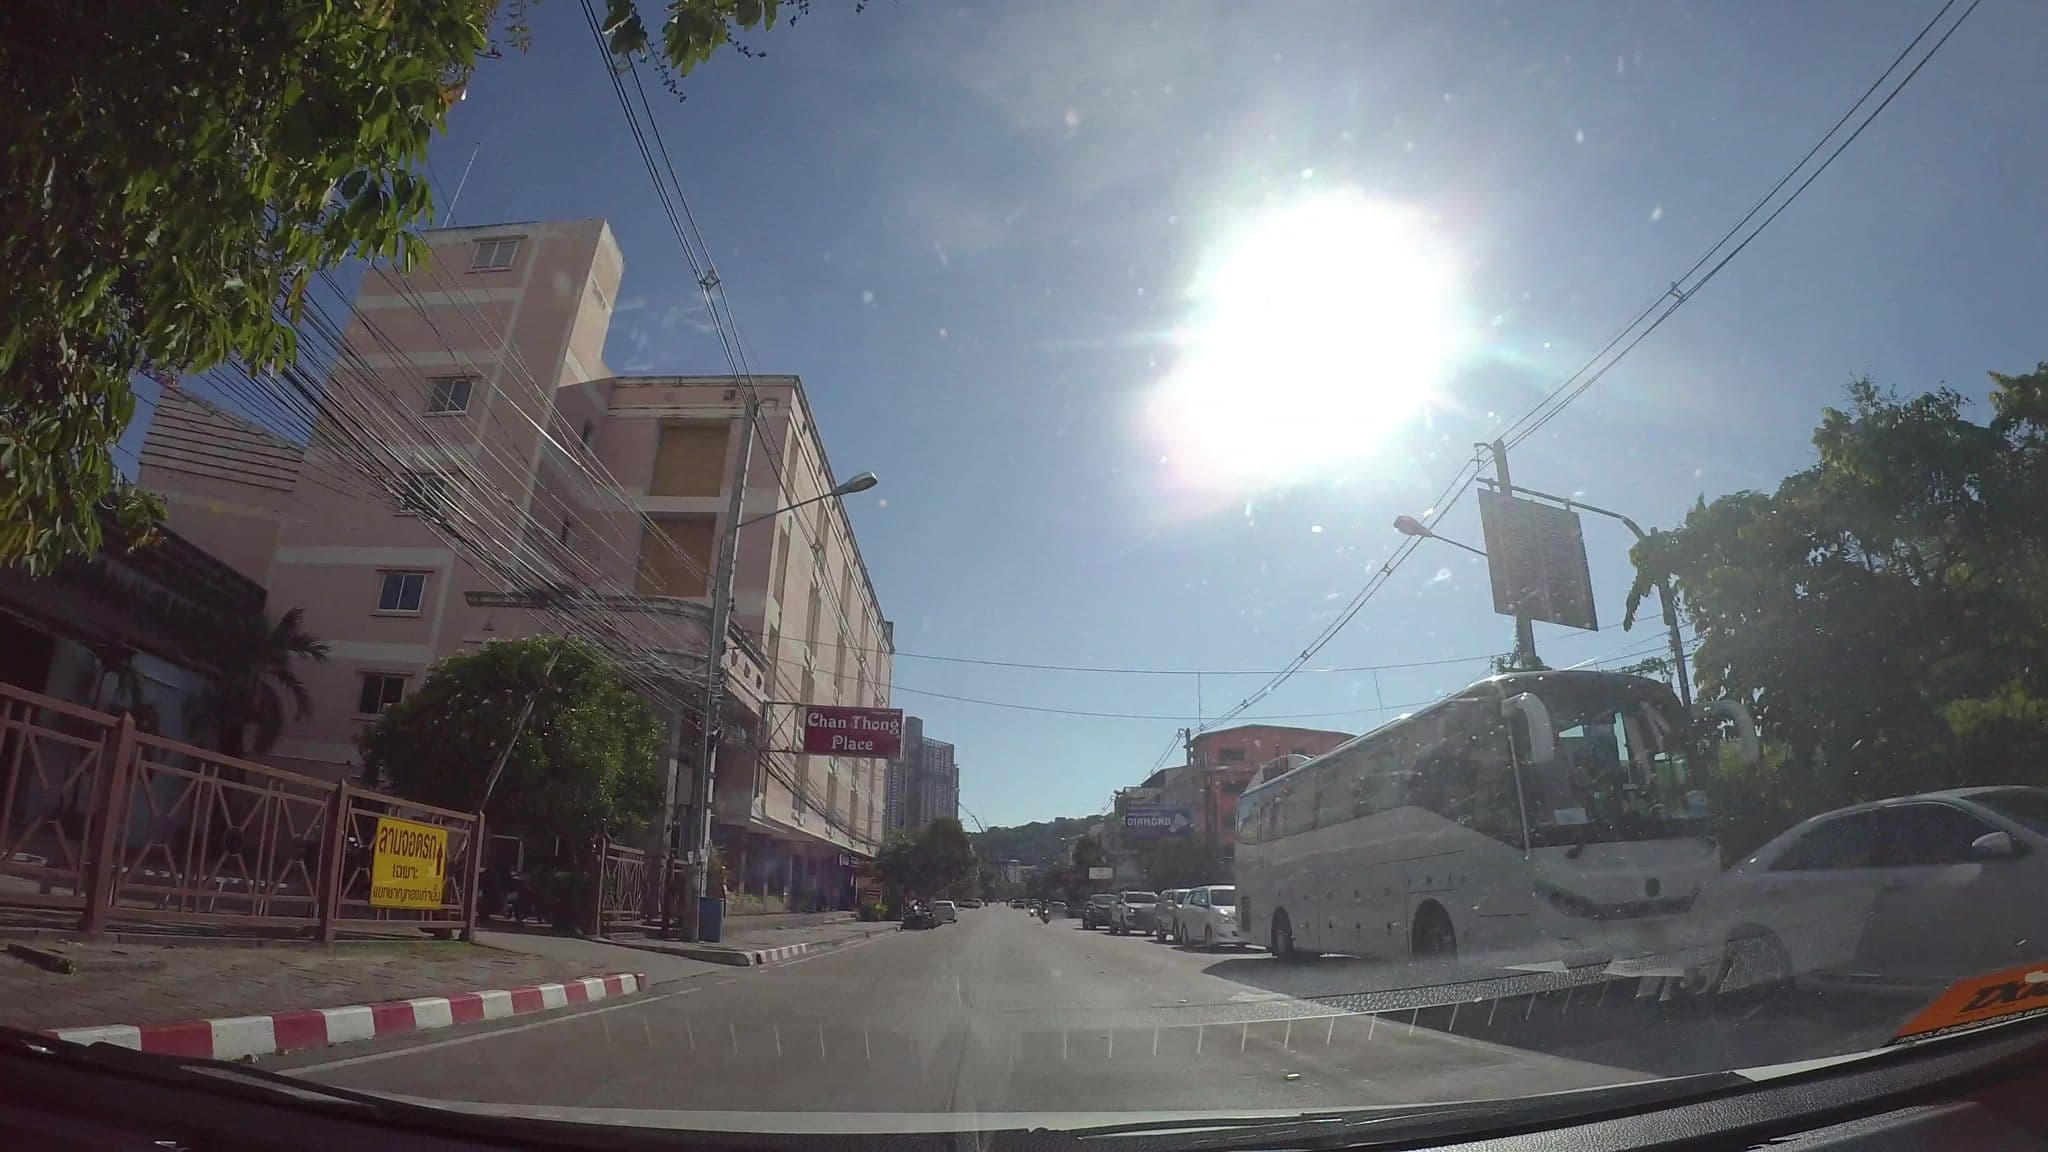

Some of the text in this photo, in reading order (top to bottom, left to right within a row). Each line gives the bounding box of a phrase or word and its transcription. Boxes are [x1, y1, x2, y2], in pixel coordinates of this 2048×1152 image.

[807, 712, 900, 735] Chan Thong
[831, 735, 874, 750] Place
[1127, 817, 1171, 827] DIAMOND
[379, 827, 437, 860] ลานจอดรถ
[393, 864, 418, 880] เฉพาะ
